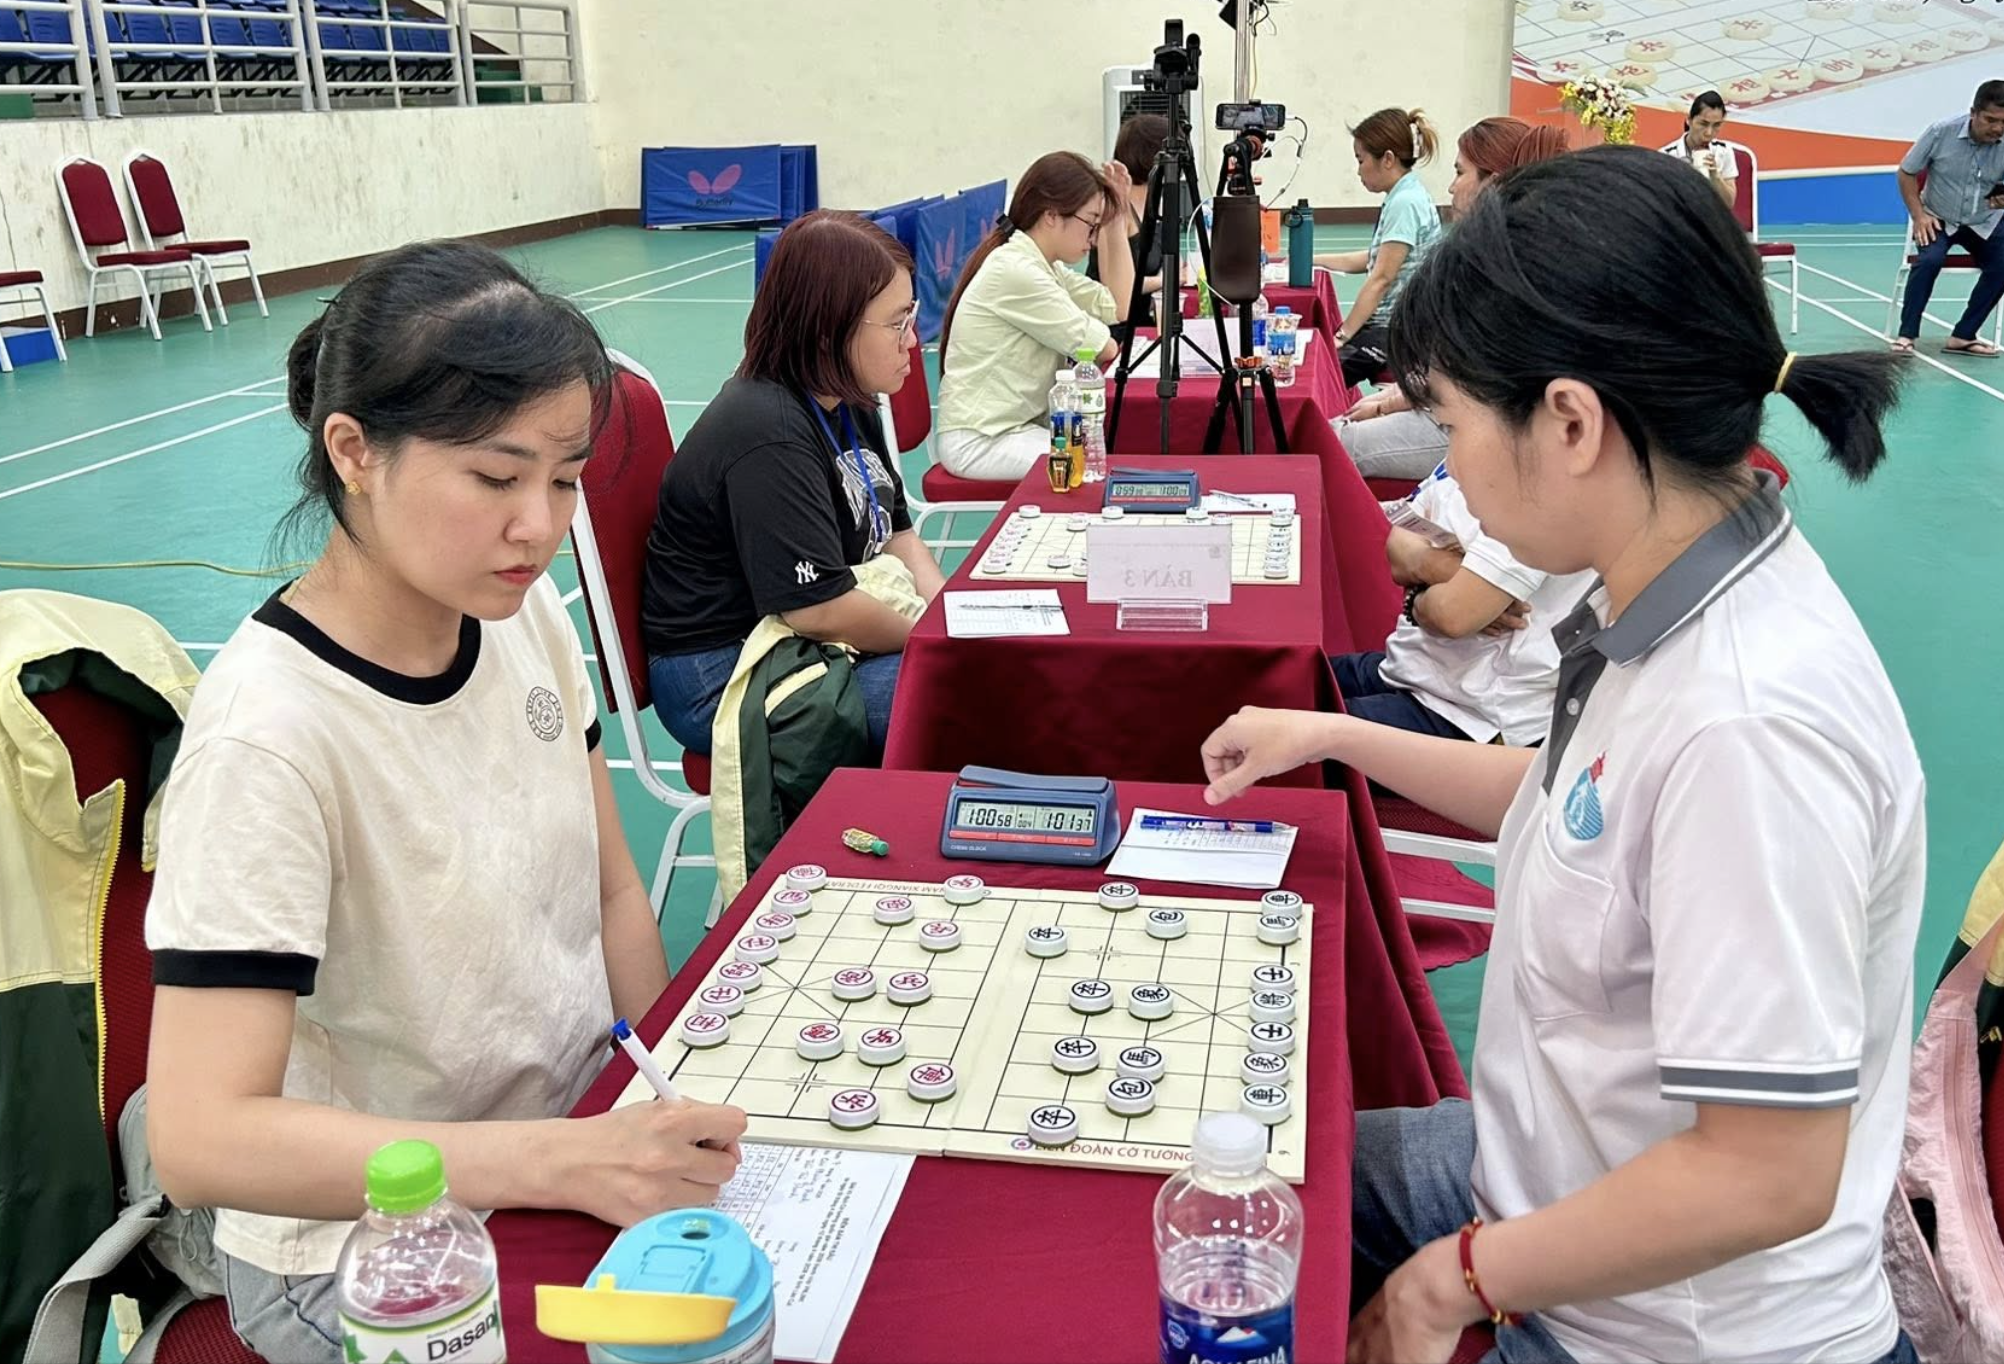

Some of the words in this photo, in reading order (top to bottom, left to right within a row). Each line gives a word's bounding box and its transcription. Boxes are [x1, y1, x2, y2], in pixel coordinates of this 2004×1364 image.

[795, 561, 819, 584] NY
[1106, 884, 1130, 895] 卒
[1035, 927, 1060, 939] 卒
[1077, 983, 1107, 996] 卒
[1258, 1024, 1284, 1039] 士
[1061, 1040, 1092, 1054] 卒
[1126, 1050, 1156, 1065] 馬
[1249, 1087, 1282, 1104] 車
[1037, 1109, 1072, 1126] 卒
